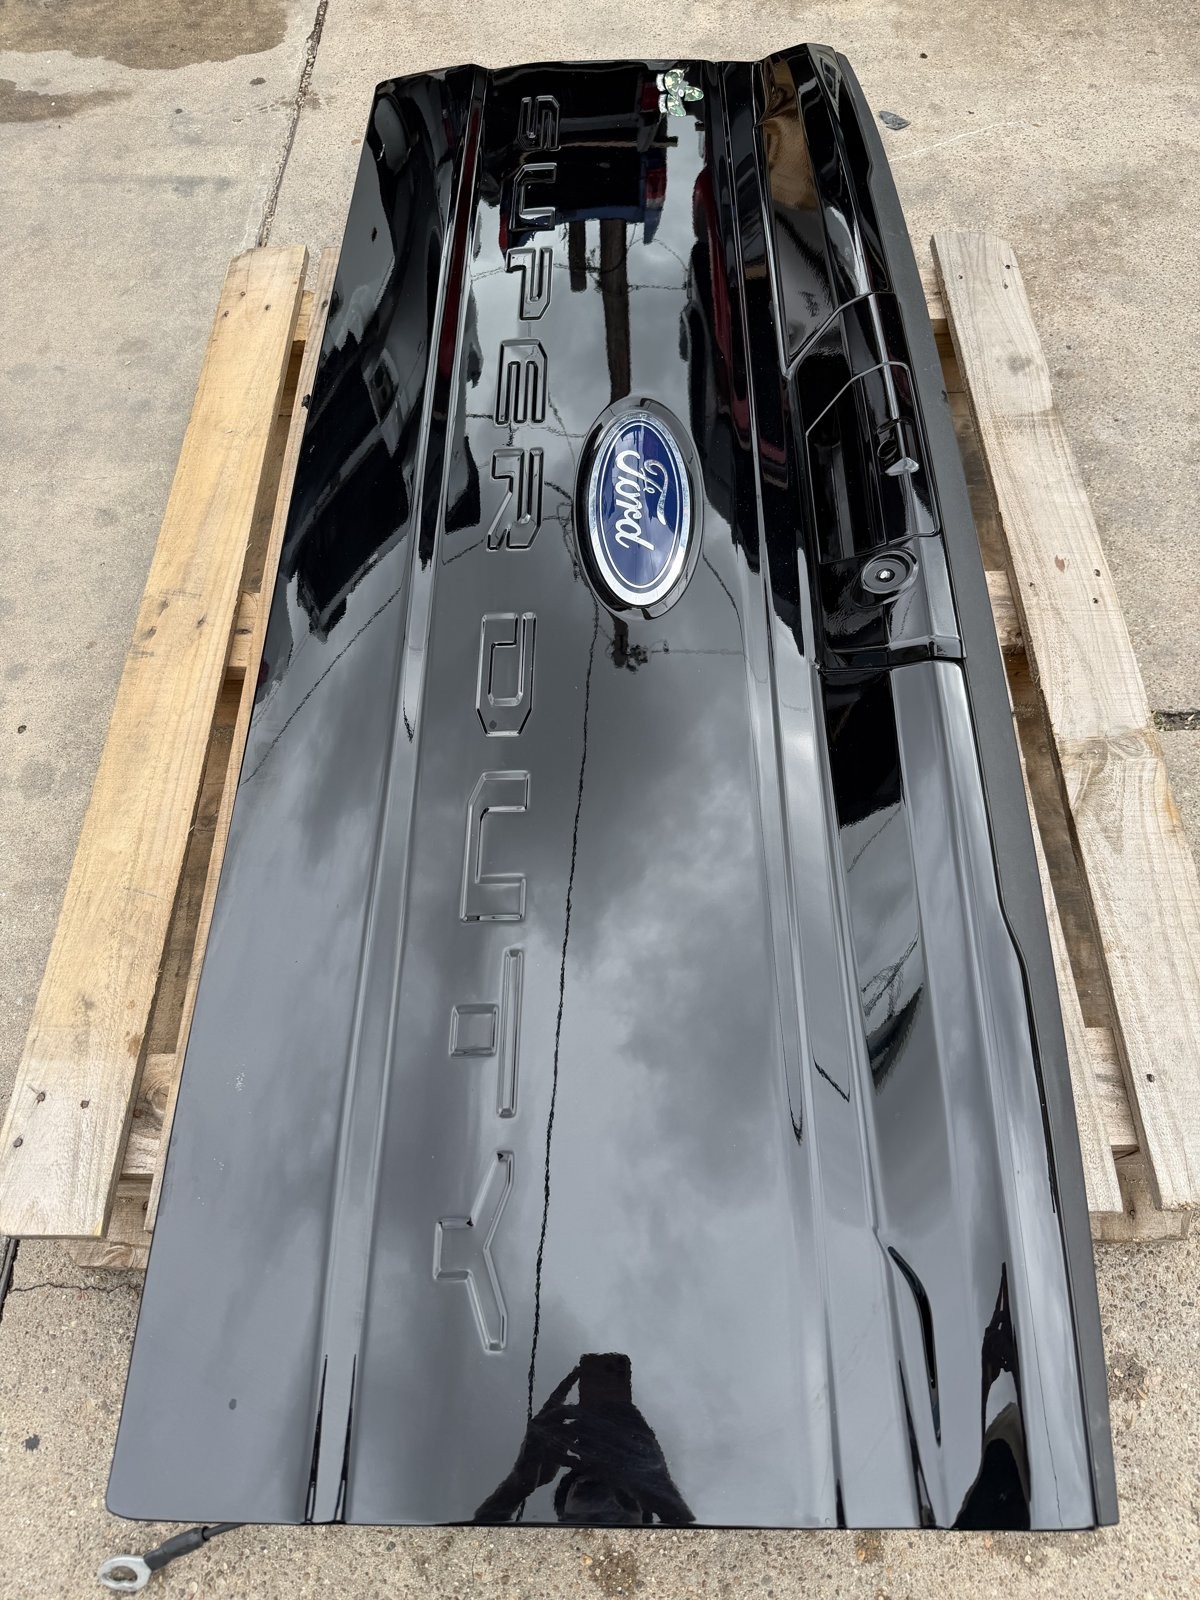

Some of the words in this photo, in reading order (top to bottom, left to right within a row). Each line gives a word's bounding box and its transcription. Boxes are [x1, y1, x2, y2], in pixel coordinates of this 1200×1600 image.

[486, 95, 561, 551] SUPER
[615, 449, 668, 551] Ford
[432, 611, 538, 1354] DUTY
